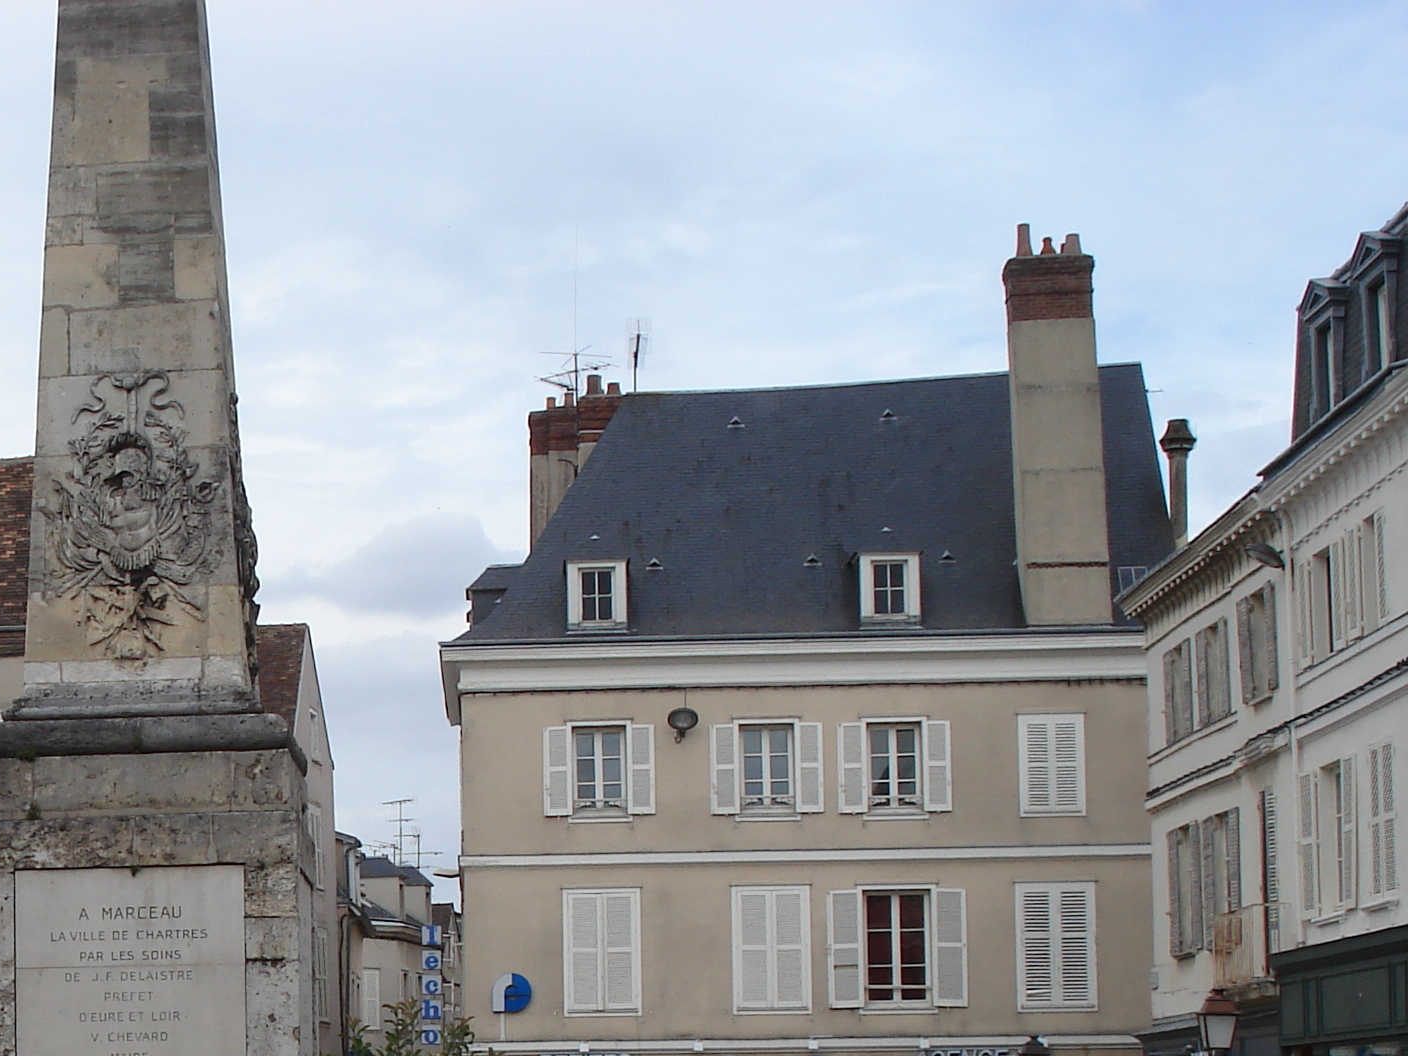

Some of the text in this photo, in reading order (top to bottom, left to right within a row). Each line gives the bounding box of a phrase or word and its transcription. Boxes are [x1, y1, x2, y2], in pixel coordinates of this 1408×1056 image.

[79, 905, 182, 921] A MARCEAU
[50, 928, 208, 942] LA VILLE DE CHARTRES
[79, 949, 182, 962] PAR LES SOINS
[64, 972, 81, 983] DE
[120, 970, 194, 981] DELAISTRE
[103, 991, 154, 1002] PREFET
[79, 1010, 181, 1023] D'EURE ET LOIR
[107, 1031, 168, 1042] CHEVARD
